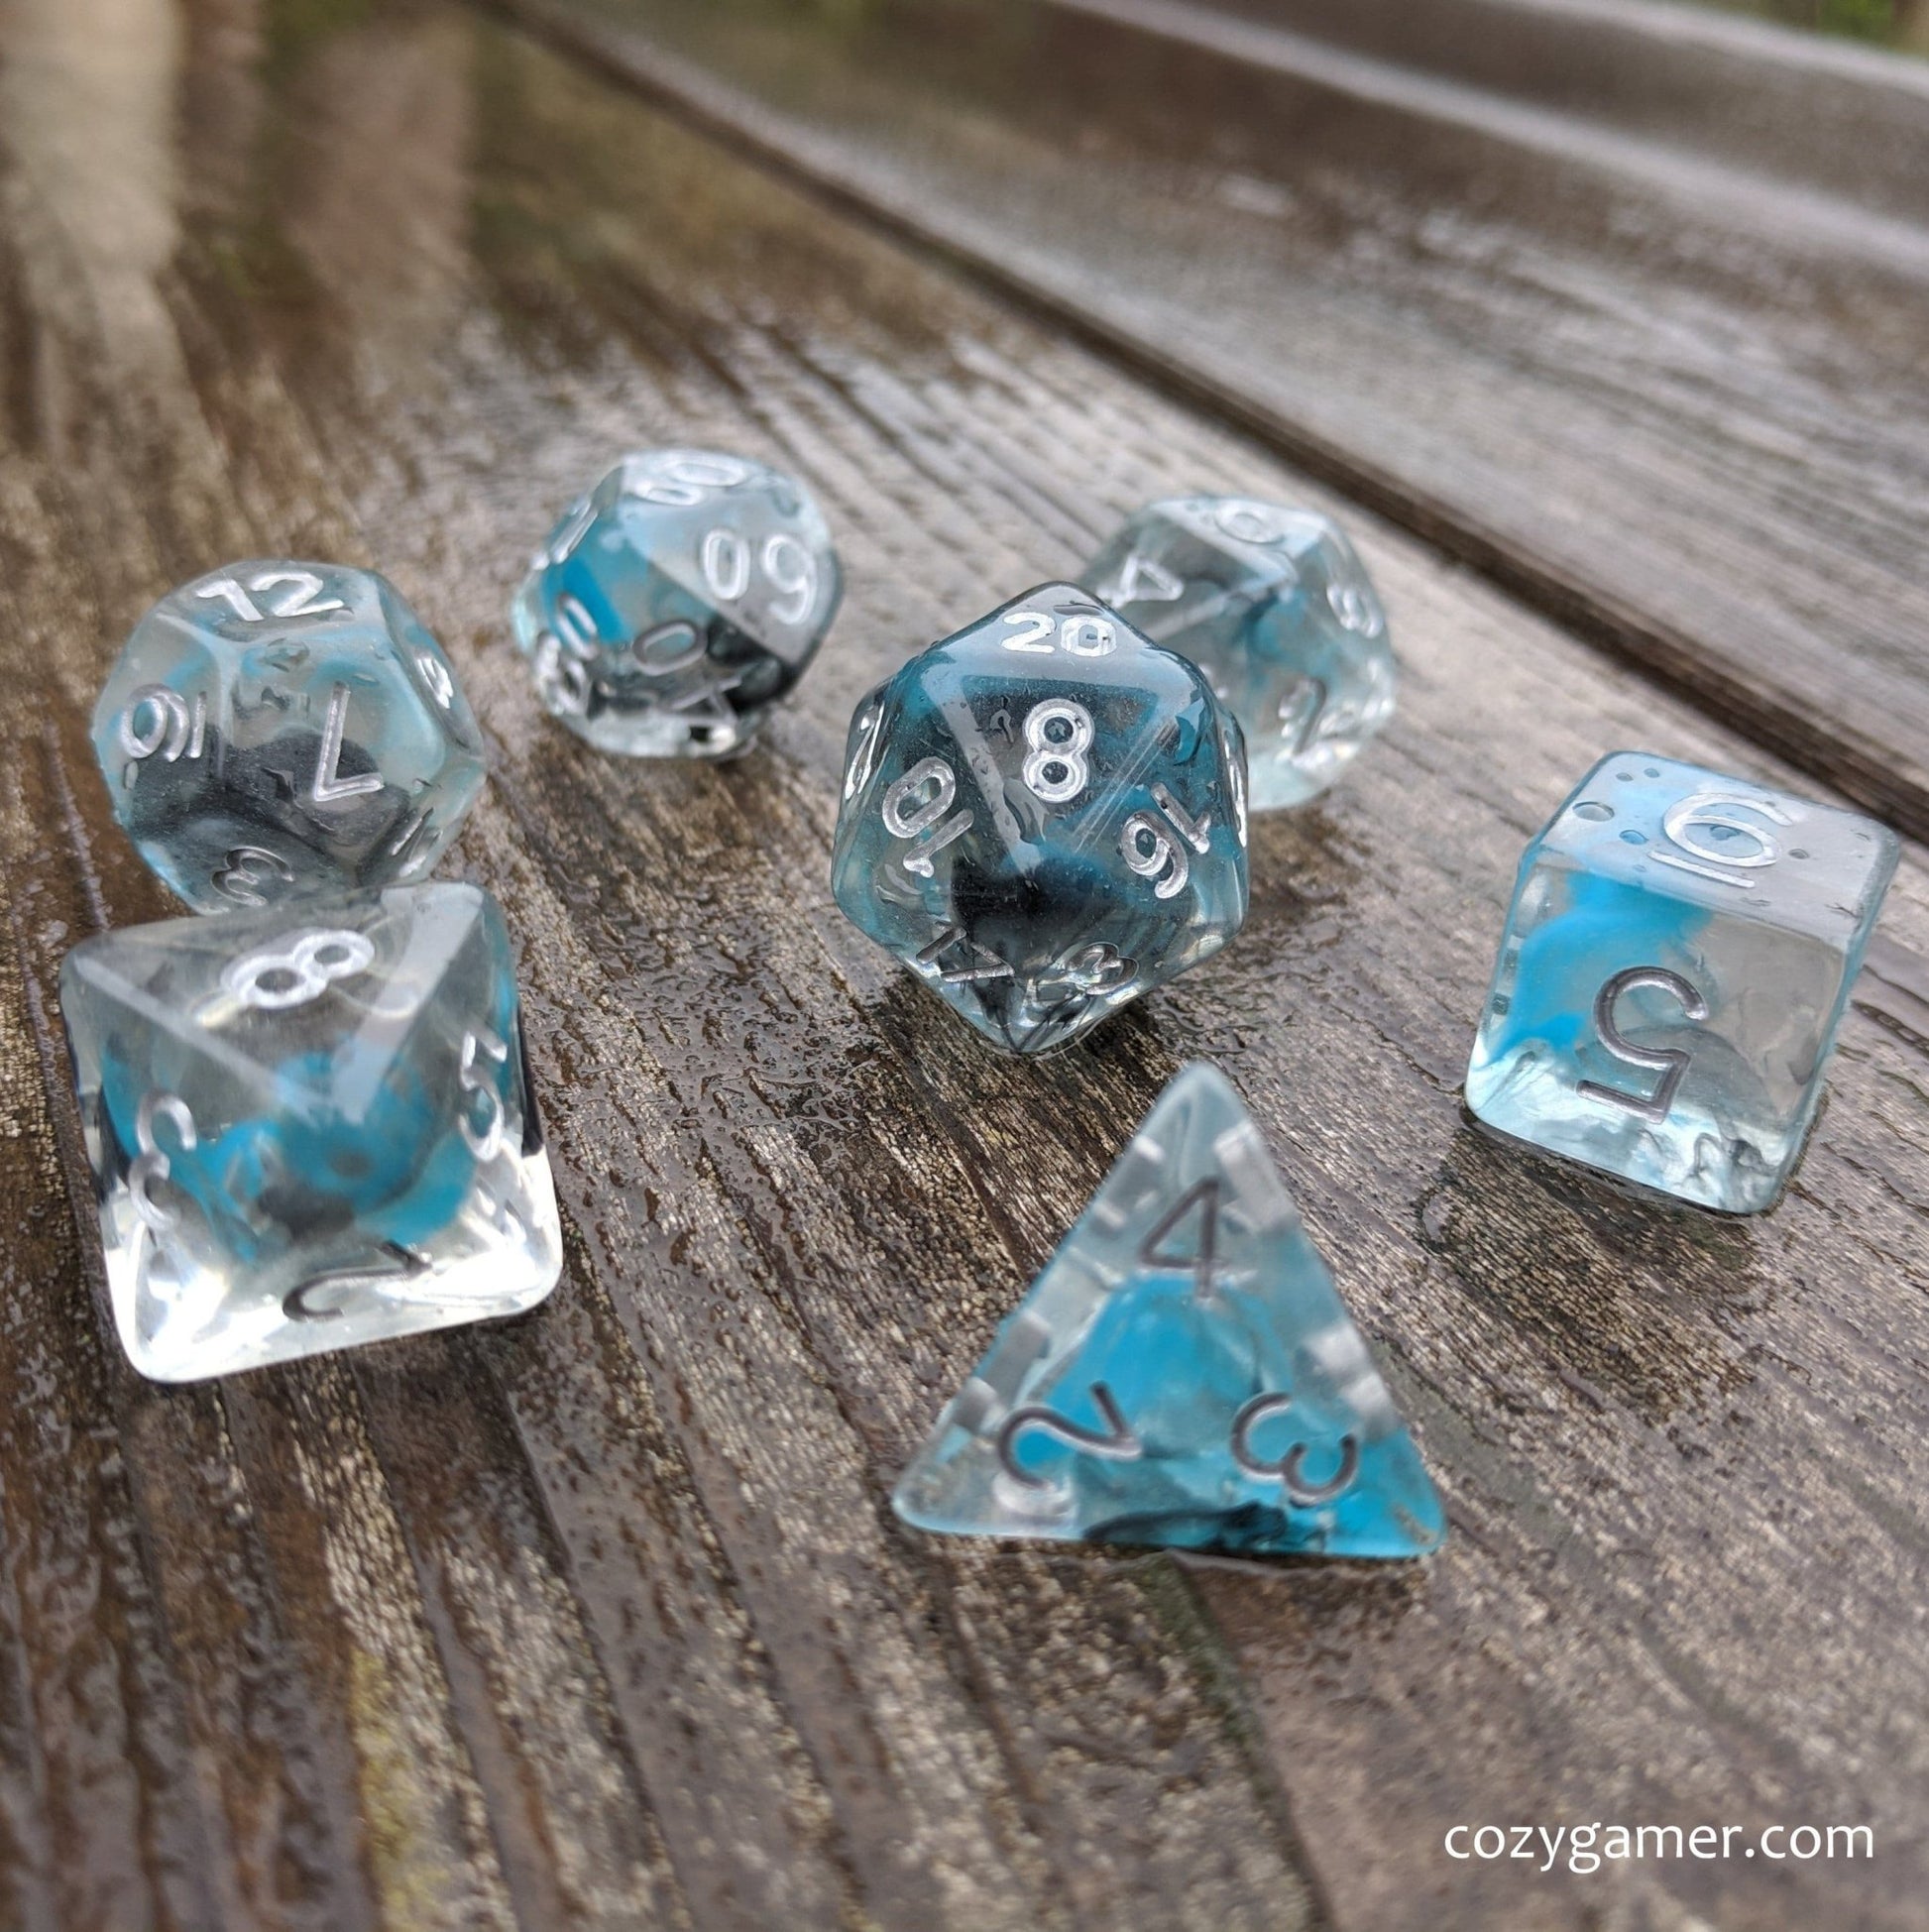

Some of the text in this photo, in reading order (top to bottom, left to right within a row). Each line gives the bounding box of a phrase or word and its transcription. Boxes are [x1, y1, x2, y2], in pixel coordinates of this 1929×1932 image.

[197, 571, 346, 623] 12
[1000, 611, 1117, 657] 20
[315, 681, 385, 803] 7
[1022, 698, 1095, 804] 8
[881, 754, 974, 879] 10
[1645, 791, 1792, 888] 6
[219, 926, 376, 1011] 8
[1576, 965, 1710, 1127] 5
[1138, 1174, 1225, 1300] 4
[997, 1379, 1144, 1490] 2
[1230, 1390, 1358, 1508] 3
